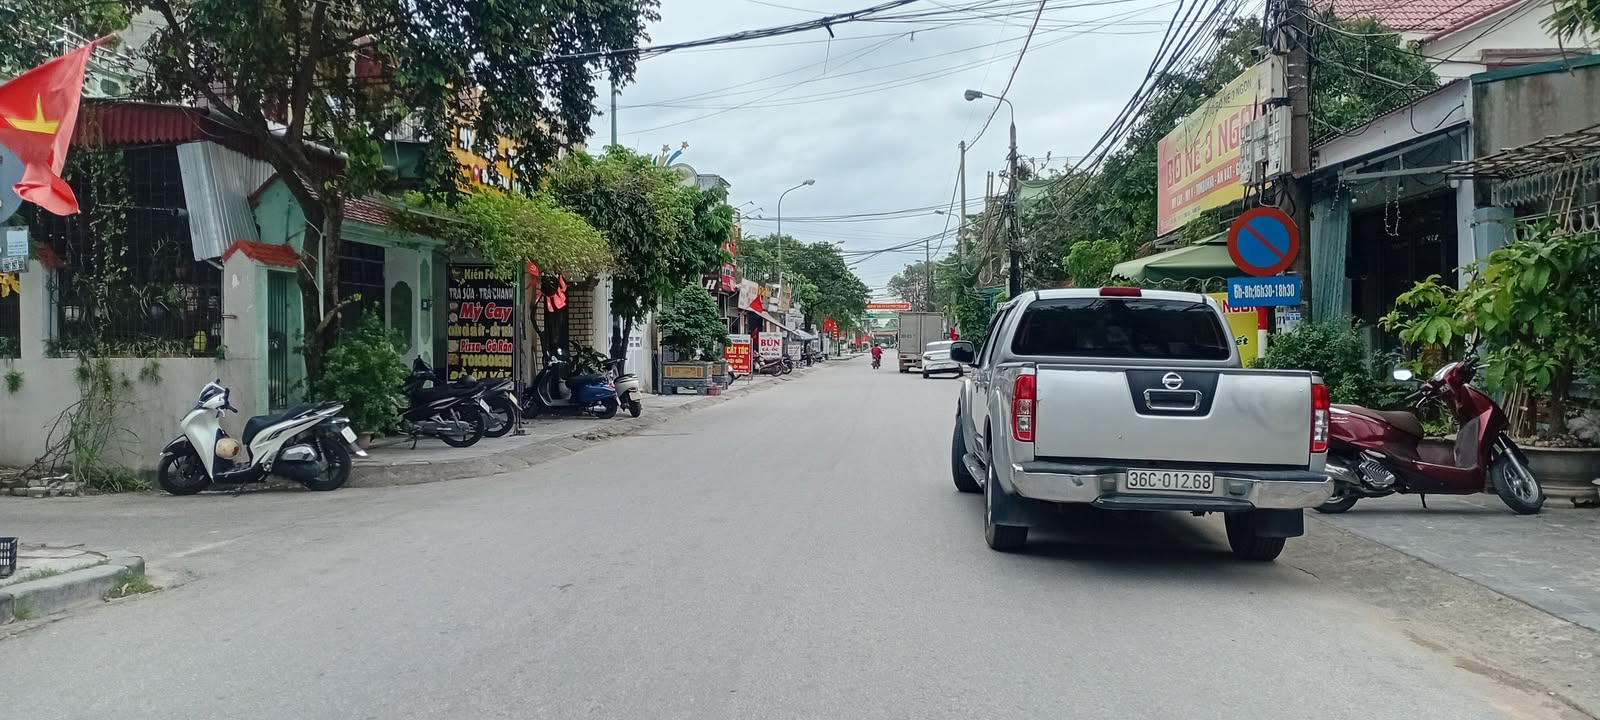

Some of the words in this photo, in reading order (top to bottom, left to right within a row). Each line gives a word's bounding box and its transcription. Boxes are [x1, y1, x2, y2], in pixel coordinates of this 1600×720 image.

[1205, 128, 1213, 164] 3
[449, 285, 461, 299] TRÀ
[485, 302, 513, 323] Cay
[1129, 471, 1211, 489] 36C-012.68
